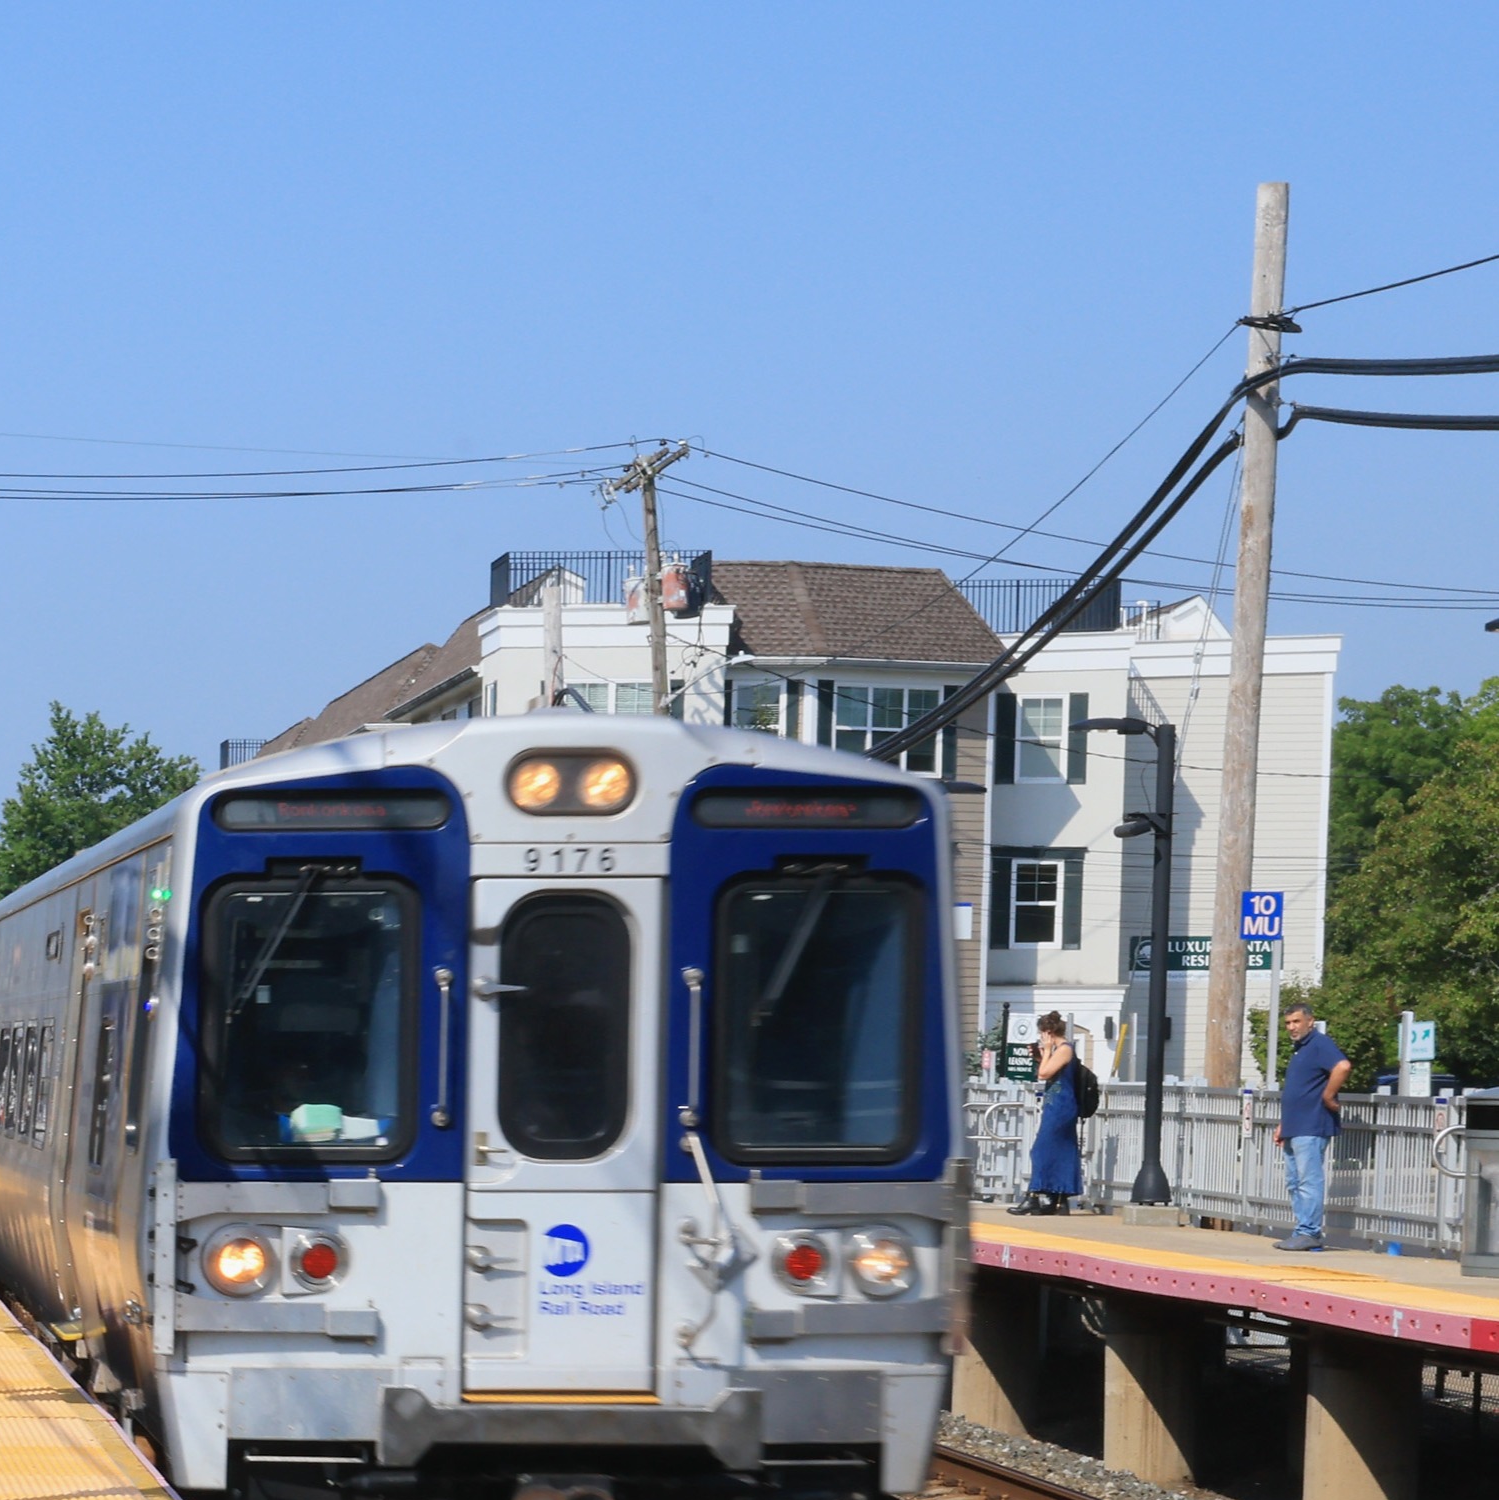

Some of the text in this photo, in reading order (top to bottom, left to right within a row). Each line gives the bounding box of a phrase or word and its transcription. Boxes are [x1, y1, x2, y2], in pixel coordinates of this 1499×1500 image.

[523, 847, 617, 873] 9176
[1250, 895, 1277, 915] 10
[1243, 916, 1280, 936] MU
[538, 1281, 645, 1299] Long Island
[538, 1301, 626, 1315] Rail Road
